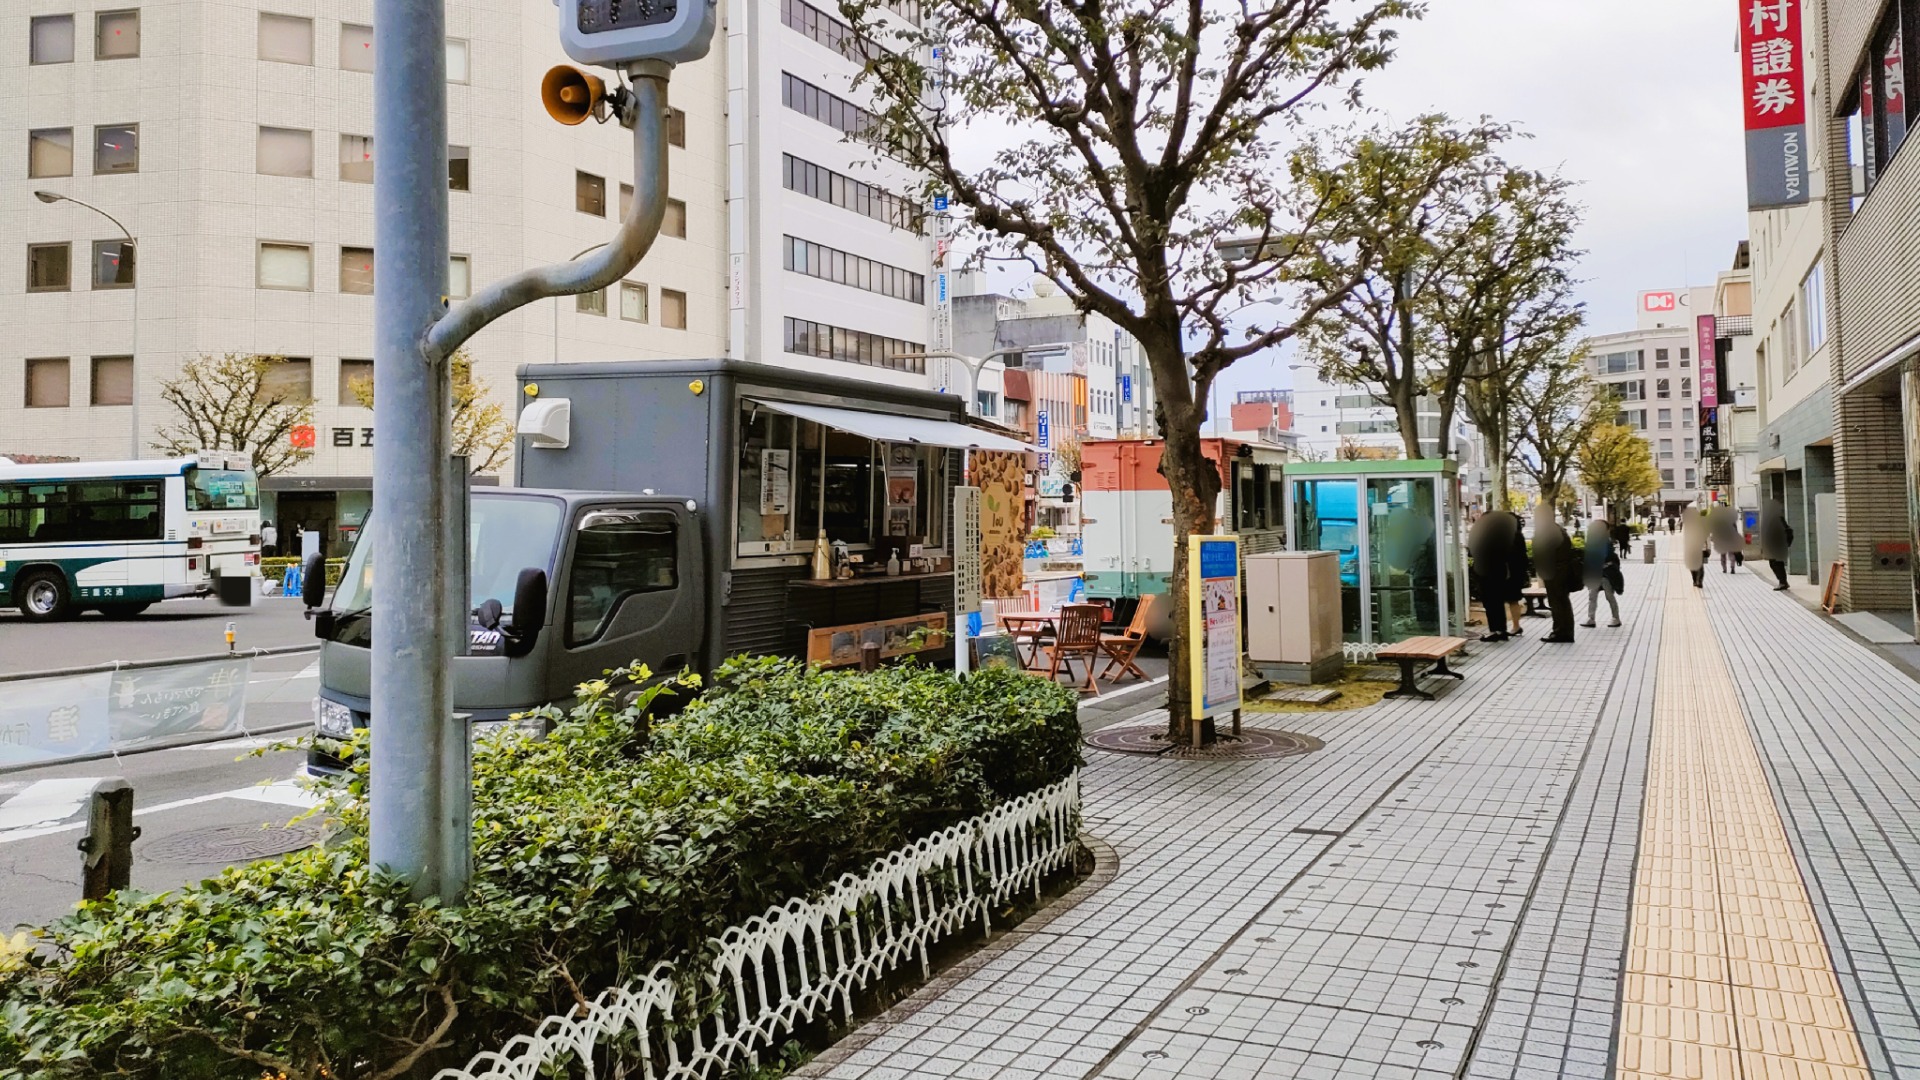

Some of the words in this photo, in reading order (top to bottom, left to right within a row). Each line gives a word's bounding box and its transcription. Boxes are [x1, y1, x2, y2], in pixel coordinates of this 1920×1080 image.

[1749, 0, 1796, 116] 村證券
[1784, 132, 1800, 199] NOMURA
[1647, 295, 1672, 309] DC
[80, 587, 124, 597] 三重交通
[470, 630, 501, 644] TAN
